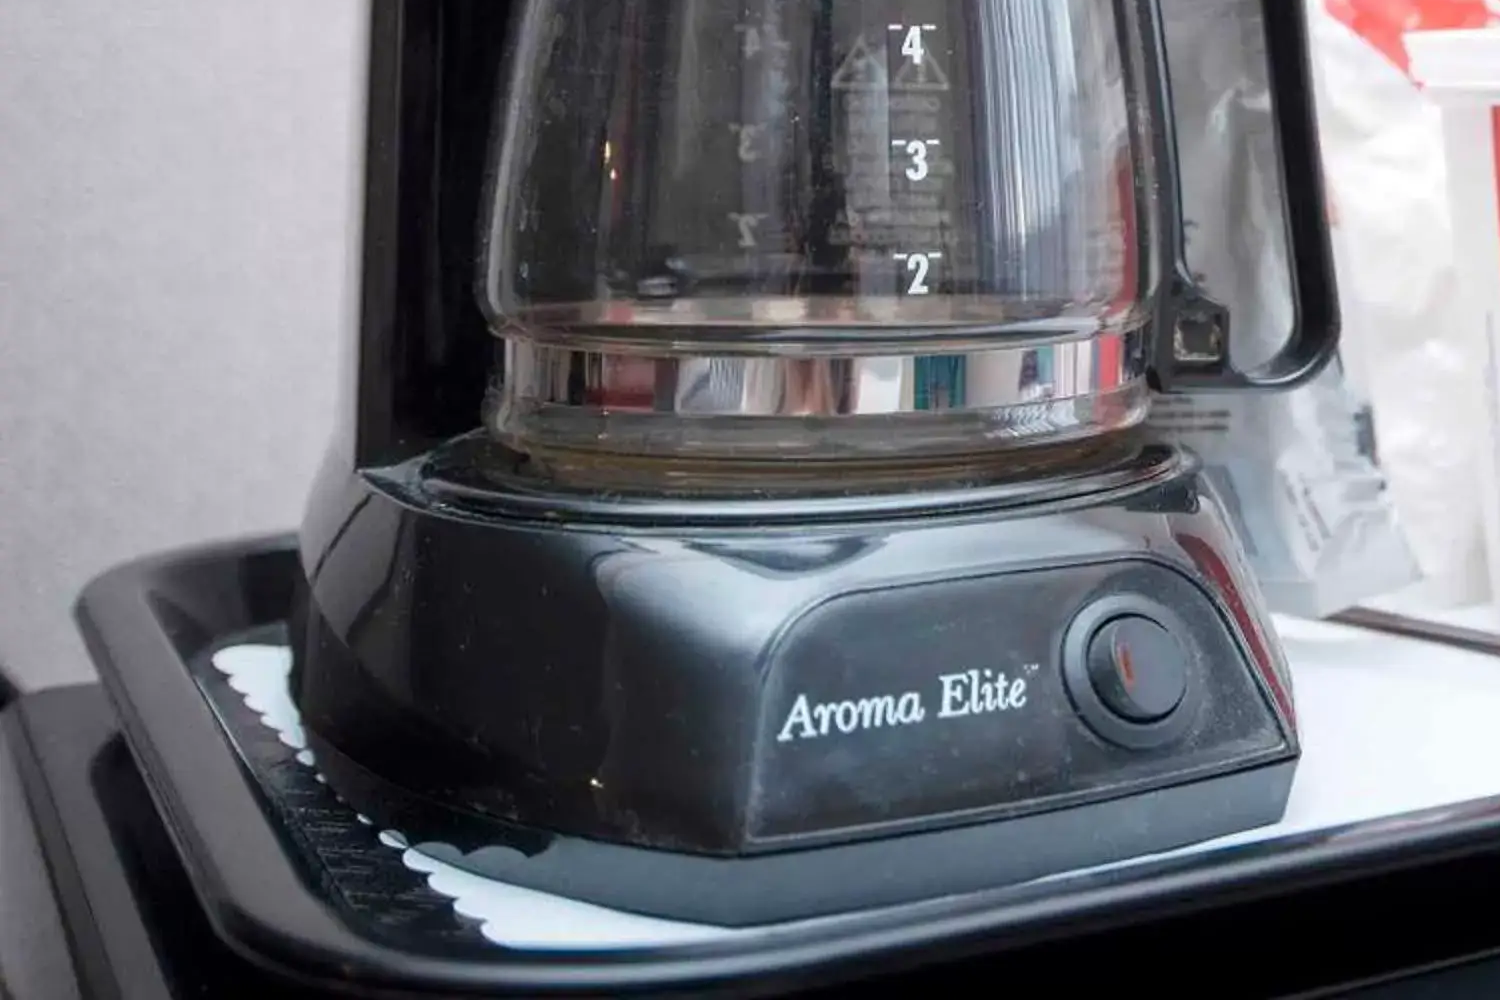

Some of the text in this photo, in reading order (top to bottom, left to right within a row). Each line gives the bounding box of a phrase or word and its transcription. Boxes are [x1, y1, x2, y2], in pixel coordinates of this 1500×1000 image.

[901, 26, 924, 64] 4
[905, 140, 928, 180] 3
[907, 254, 929, 294] 2
[777, 670, 1027, 741] Aroma Elite
